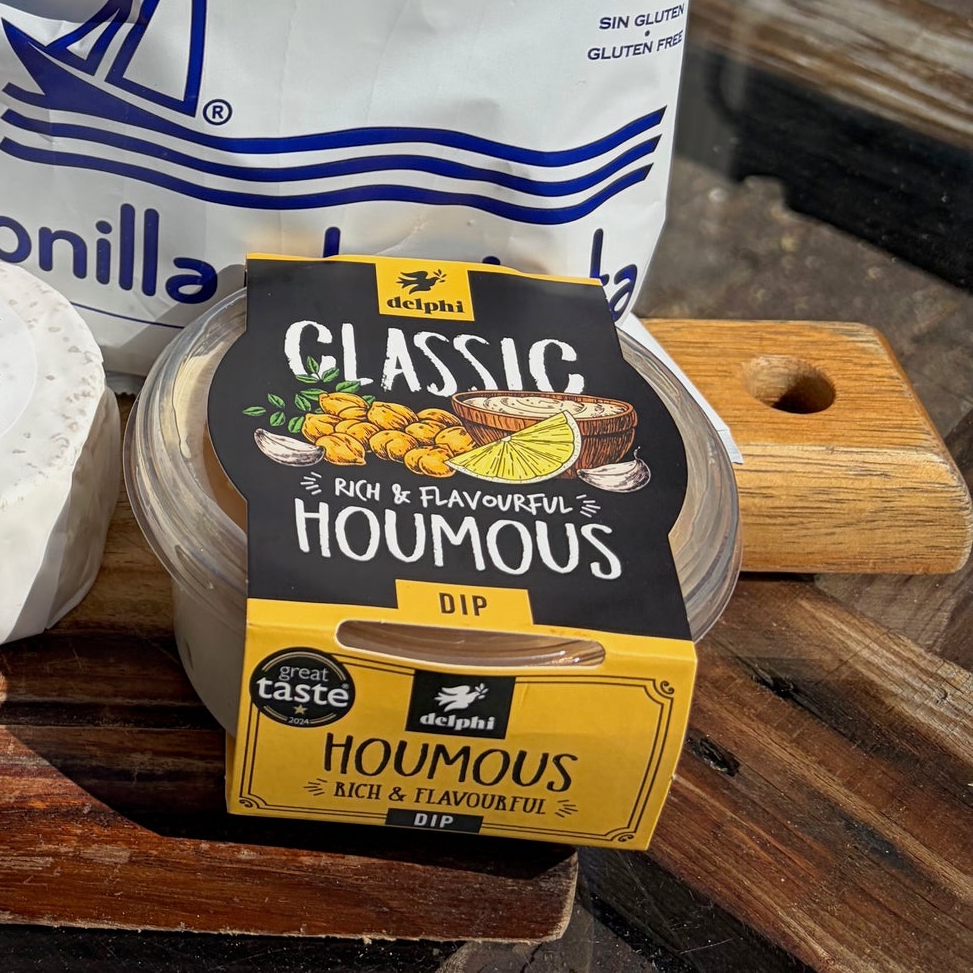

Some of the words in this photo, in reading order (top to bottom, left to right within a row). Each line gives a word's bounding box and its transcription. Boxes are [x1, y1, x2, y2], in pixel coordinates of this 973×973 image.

[599, 15, 630, 30] SIN
[634, 3, 685, 27] GLUTEN
[587, 40, 653, 61] GLUTEN
[656, 30, 684, 52] FREE
[386, 295, 465, 315] delphi
[284, 320, 585, 397] CLASSIC
[335, 477, 380, 502] RICH
[391, 483, 411, 505] &
[419, 486, 574, 515] FLAVOURFUL
[294, 497, 622, 580] HOUMOUS
[438, 592, 488, 616] DIP
[279, 666, 329, 682] great
[256, 677, 349, 707] taste
[288, 717, 309, 725] 2024
[419, 712, 496, 732] delphi
[323, 732, 579, 793] HOUMOUS
[333, 781, 382, 802] RICH
[388, 785, 406, 802] &
[414, 787, 546, 815] FLAVOURFUL
[414, 812, 454, 829] DIP
